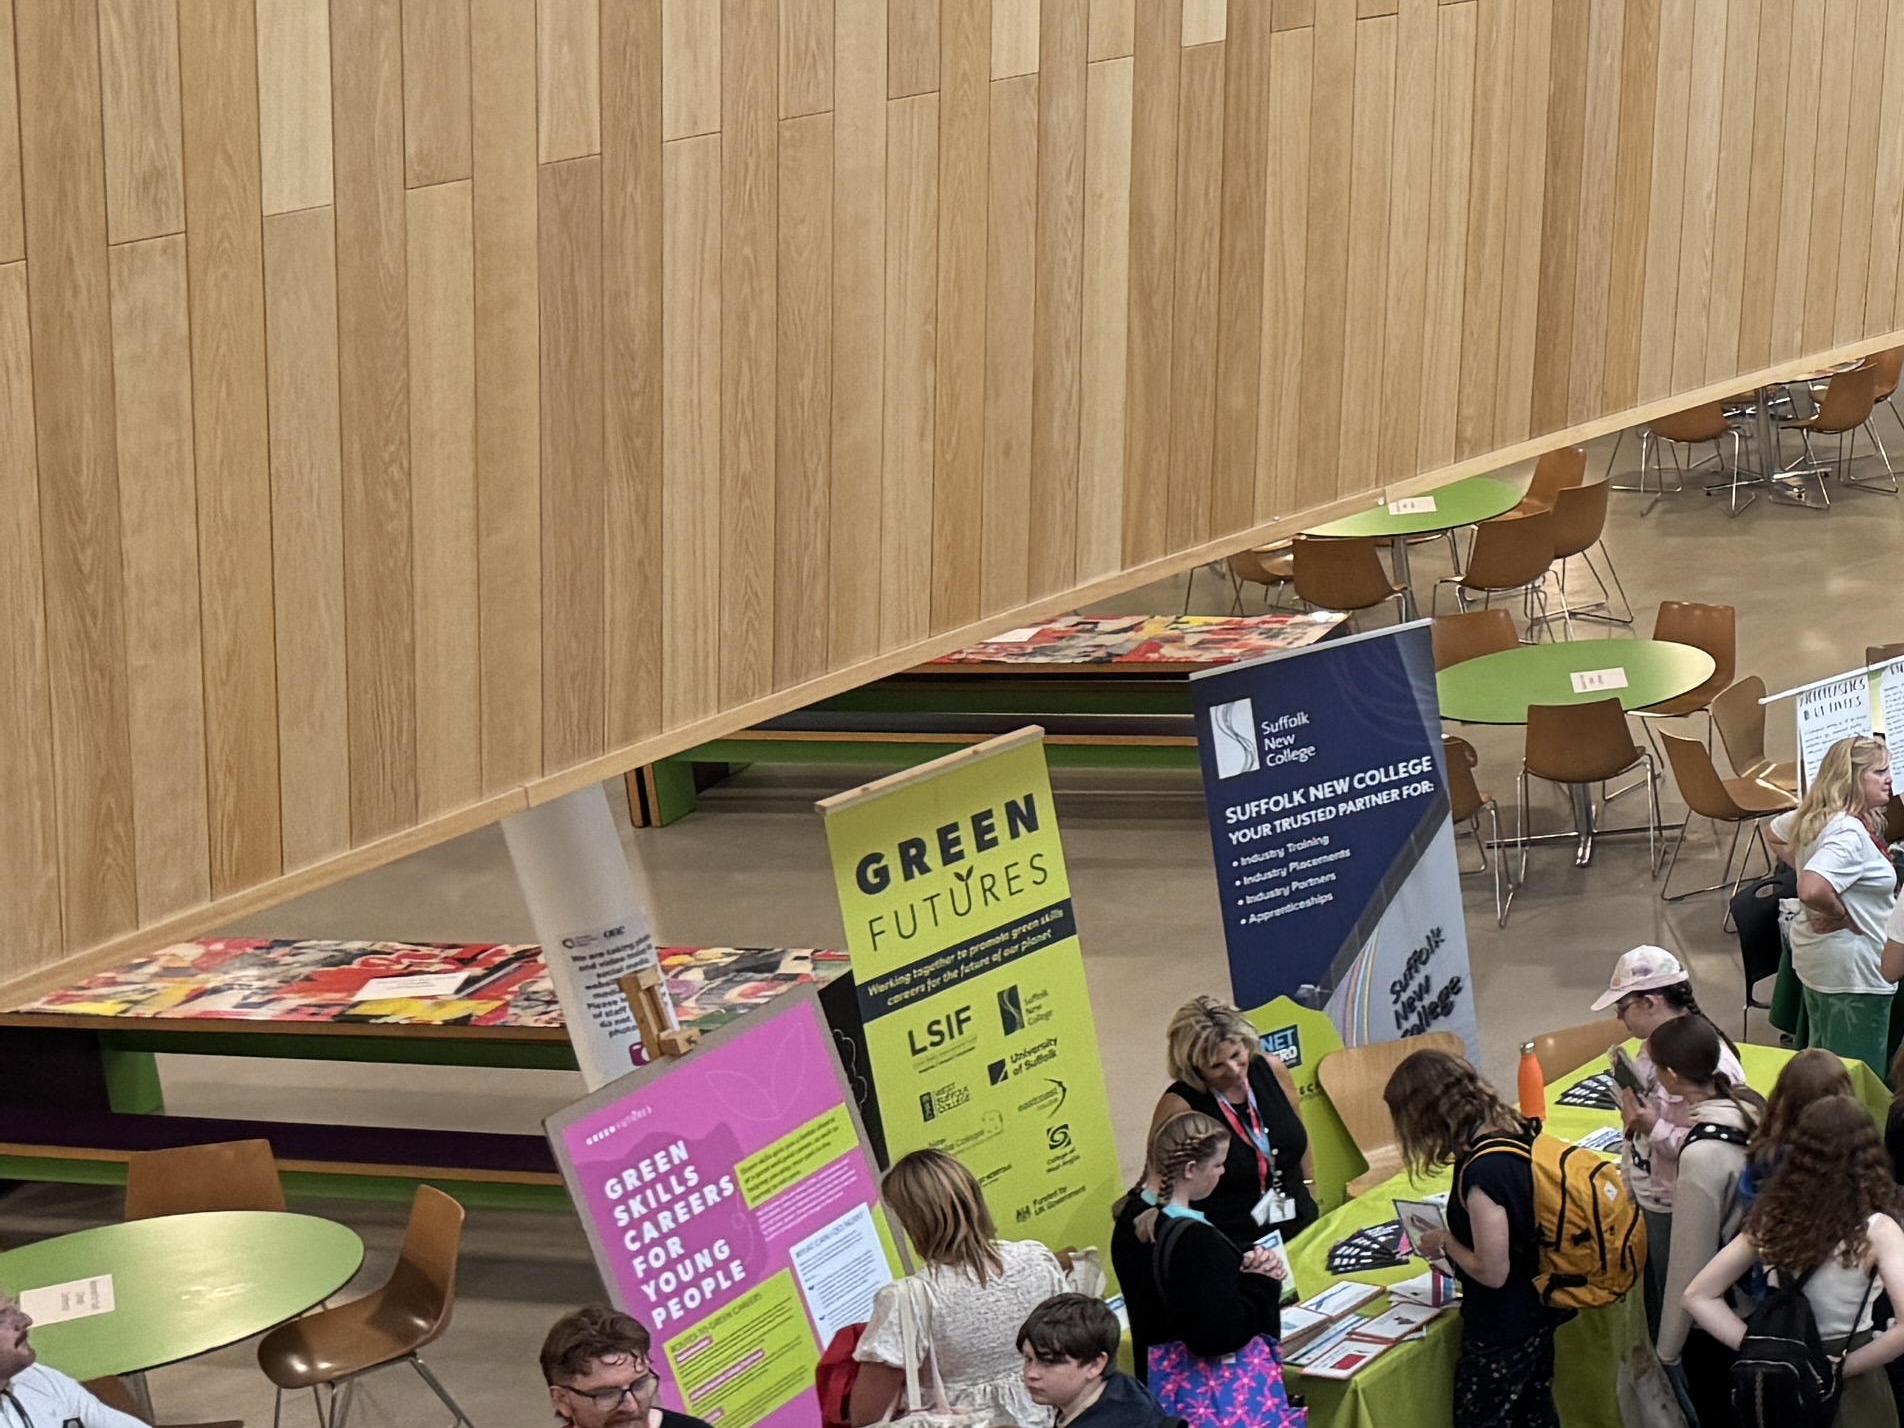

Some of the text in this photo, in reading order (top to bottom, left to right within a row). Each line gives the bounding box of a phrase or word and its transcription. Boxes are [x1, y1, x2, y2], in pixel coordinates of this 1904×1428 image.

[1261, 712, 1310, 735] Suffolk
[1264, 733, 1295, 751] New
[1266, 744, 1316, 767] College
[1225, 756, 1433, 824] SUFFOLK NEW COLLEGE
[1229, 781, 1434, 845] YOUR TRUSTED PARTNER FOR:
[856, 793, 1039, 895] GREEN
[1240, 835, 1329, 866] Industry Training
[1243, 848, 1351, 885] Industry Placements
[869, 853, 1048, 951] FUTURES
[1246, 872, 1337, 905] Industry Partners
[1248, 892, 1334, 924] Apprenticeships
[868, 973, 911, 996] Working
[913, 954, 955, 983] together
[957, 949, 968, 961] to
[969, 931, 1009, 958] promote
[1012, 919, 1040, 941] green
[887, 985, 925, 1006] careers
[926, 976, 941, 995] for
[943, 968, 958, 983] the
[960, 957, 989, 980] future
[992, 949, 1002, 965] of
[1021, 929, 1052, 952] planet
[1390, 926, 1445, 1005] Suffolk
[908, 1005, 971, 1056] LSIF
[1394, 975, 1431, 1030] New
[1011, 1038, 1057, 1064] University
[1261, 1030, 1294, 1051] NET
[605, 1140, 689, 1200] GREEN
[614, 1166, 699, 1227] SKILLS
[624, 1175, 735, 1251] CAREERS
[632, 1236, 685, 1278] FOR
[641, 1239, 731, 1302] YOUNG
[652, 1259, 746, 1329] PEOPLE
